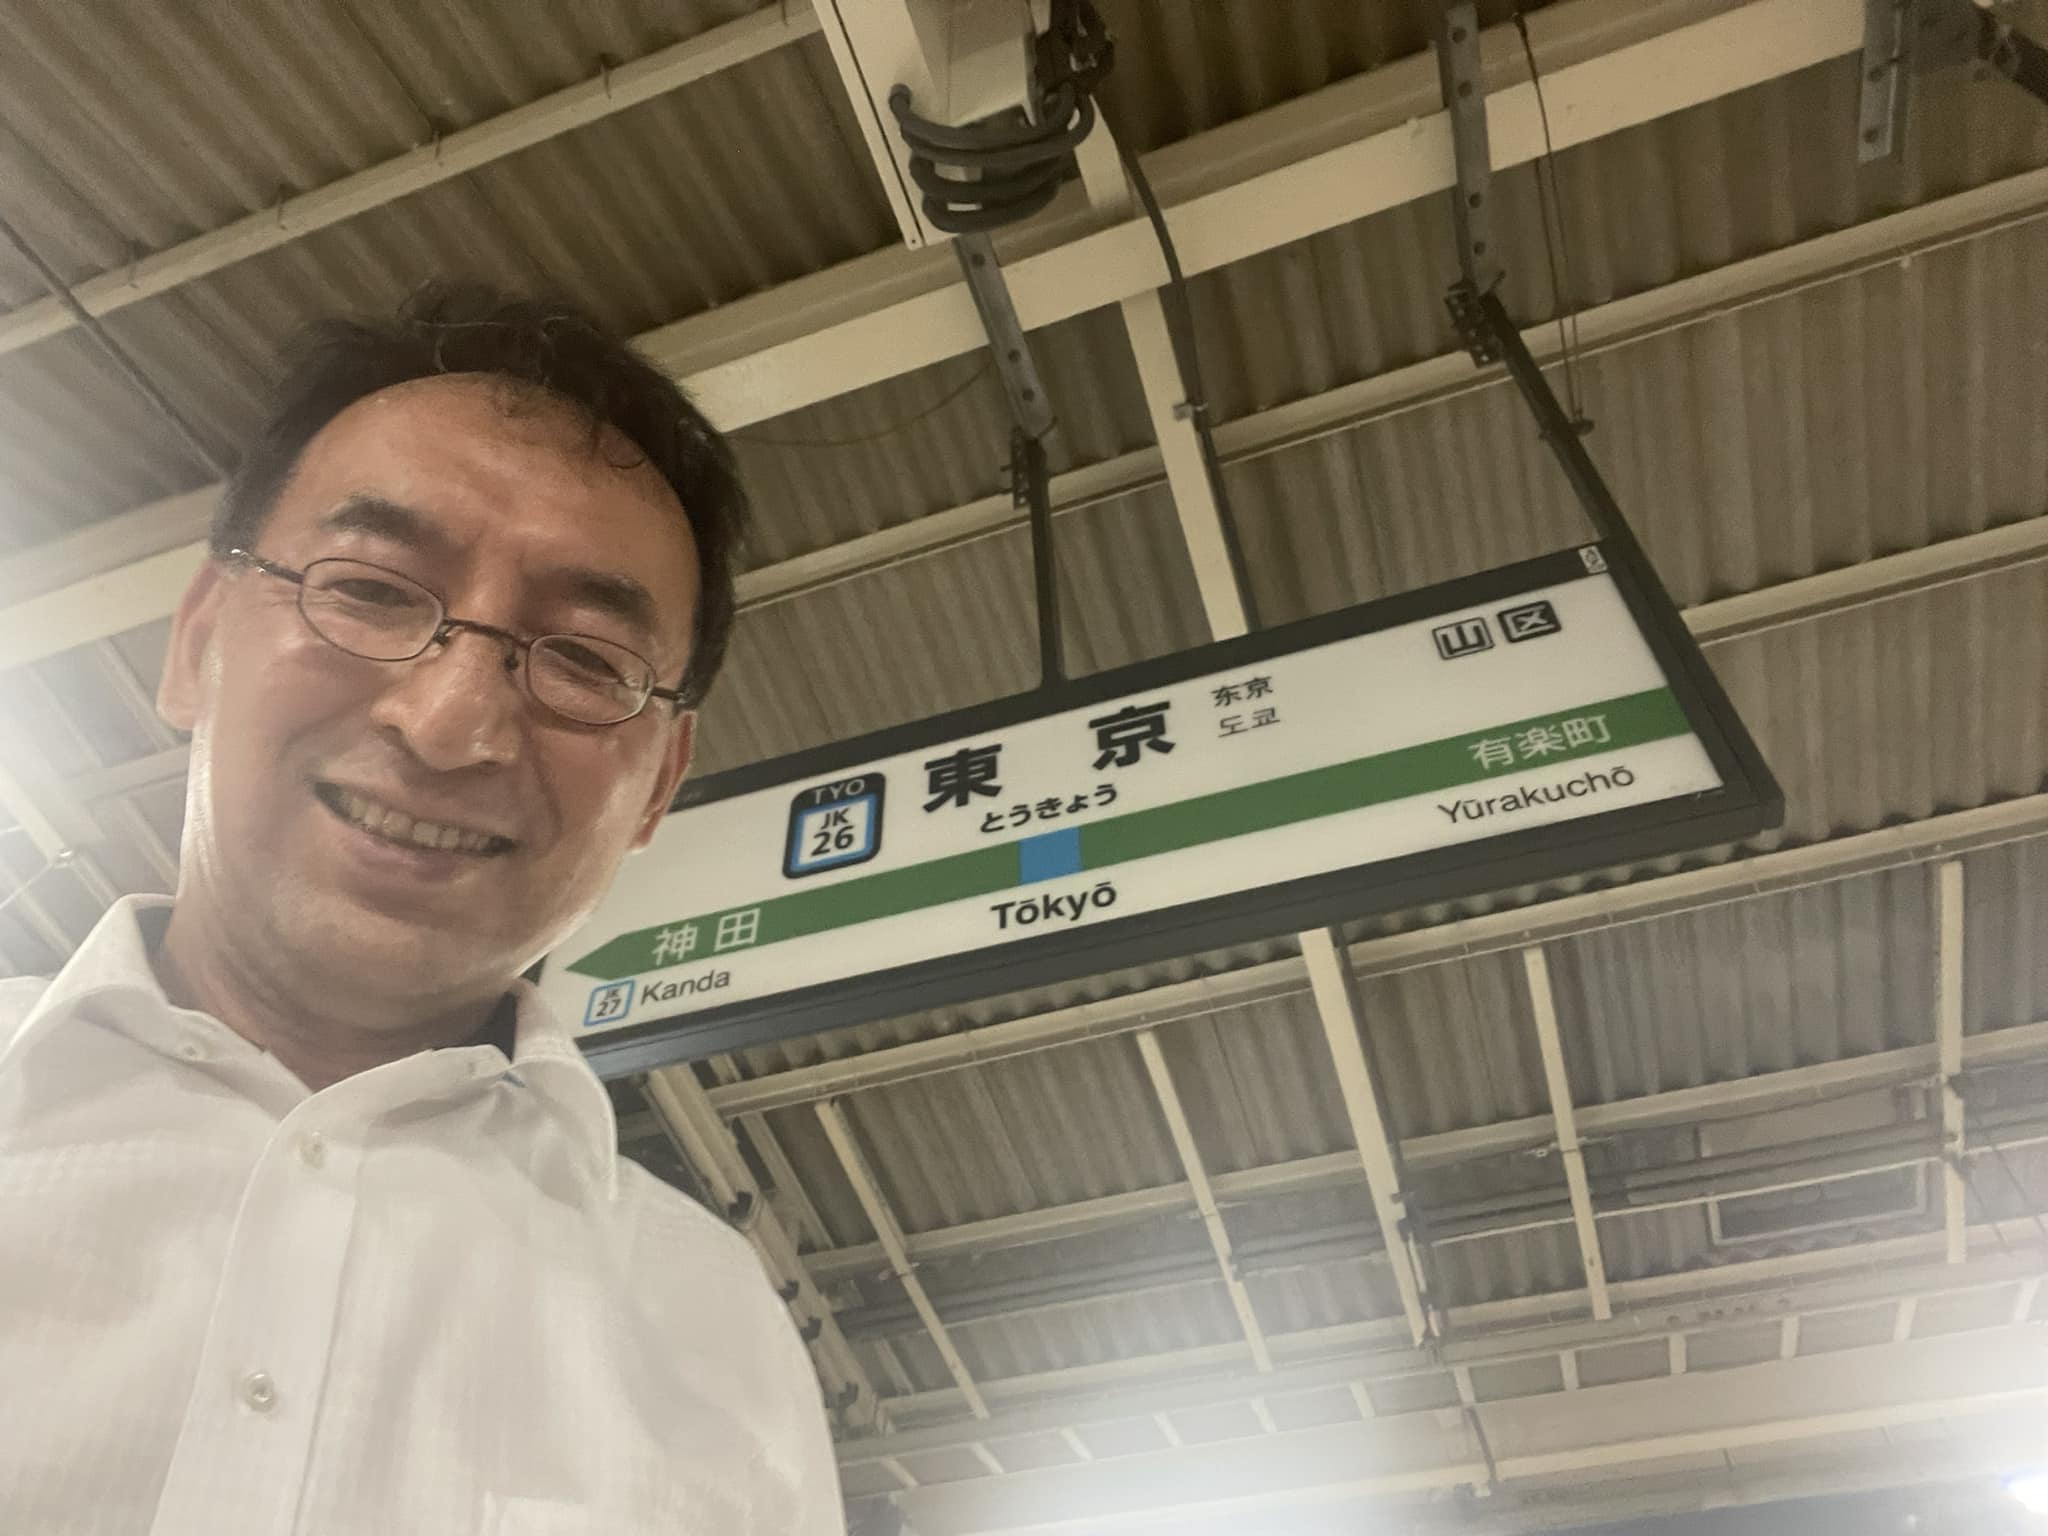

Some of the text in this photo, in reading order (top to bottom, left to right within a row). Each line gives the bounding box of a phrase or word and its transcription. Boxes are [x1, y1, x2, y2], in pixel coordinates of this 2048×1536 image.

[1442, 603, 1556, 656] 山 区
[1210, 676, 1274, 708] 东京
[1218, 706, 1281, 738] 도쿄
[1469, 711, 1614, 771] 有楽町
[922, 700, 1177, 814] 東京
[814, 778, 866, 805] TYO
[979, 783, 1118, 834] とうきょう
[1436, 764, 1636, 827] Yūrakuchō
[820, 807, 850, 830] JK
[811, 825, 855, 857] 26
[989, 880, 1118, 931] Tōkyō
[651, 906, 761, 967] 神田
[595, 999, 621, 1017] 27
[640, 969, 731, 1006] Kanda
